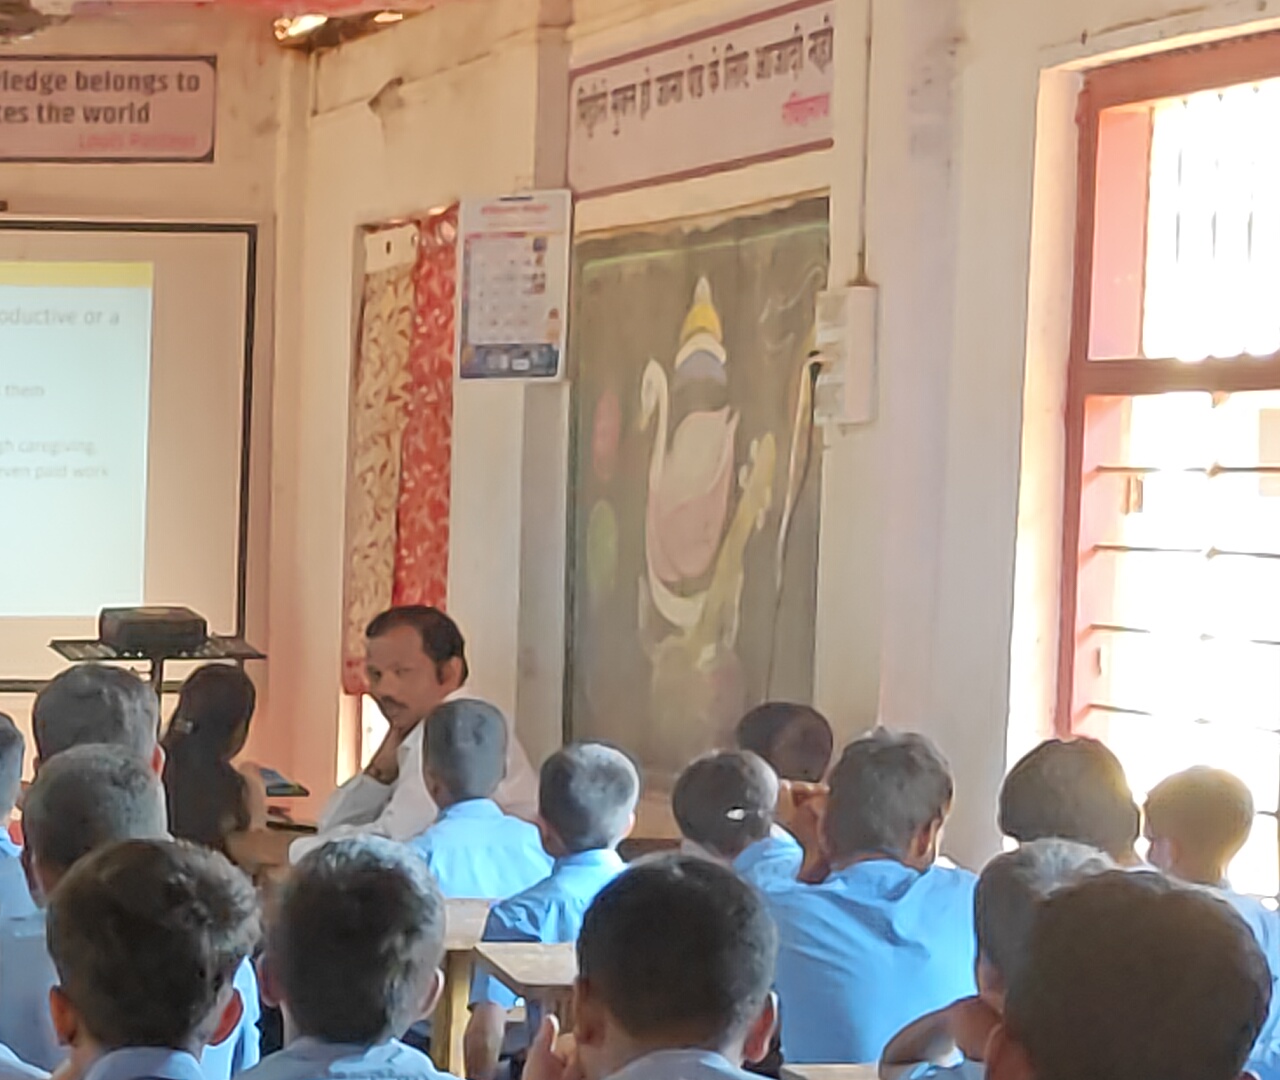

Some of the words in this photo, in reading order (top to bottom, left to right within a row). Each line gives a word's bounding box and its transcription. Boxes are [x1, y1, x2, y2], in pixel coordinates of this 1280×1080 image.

[75, 70, 169, 96] belongs
[176, 72, 201, 92] to
[36, 101, 76, 124] the
[82, 101, 151, 125] world
[84, 310, 103, 325] or
[109, 311, 120, 326] a
[5, 383, 46, 397] them
[34, 464, 68, 481] paid
[72, 465, 109, 479] work
